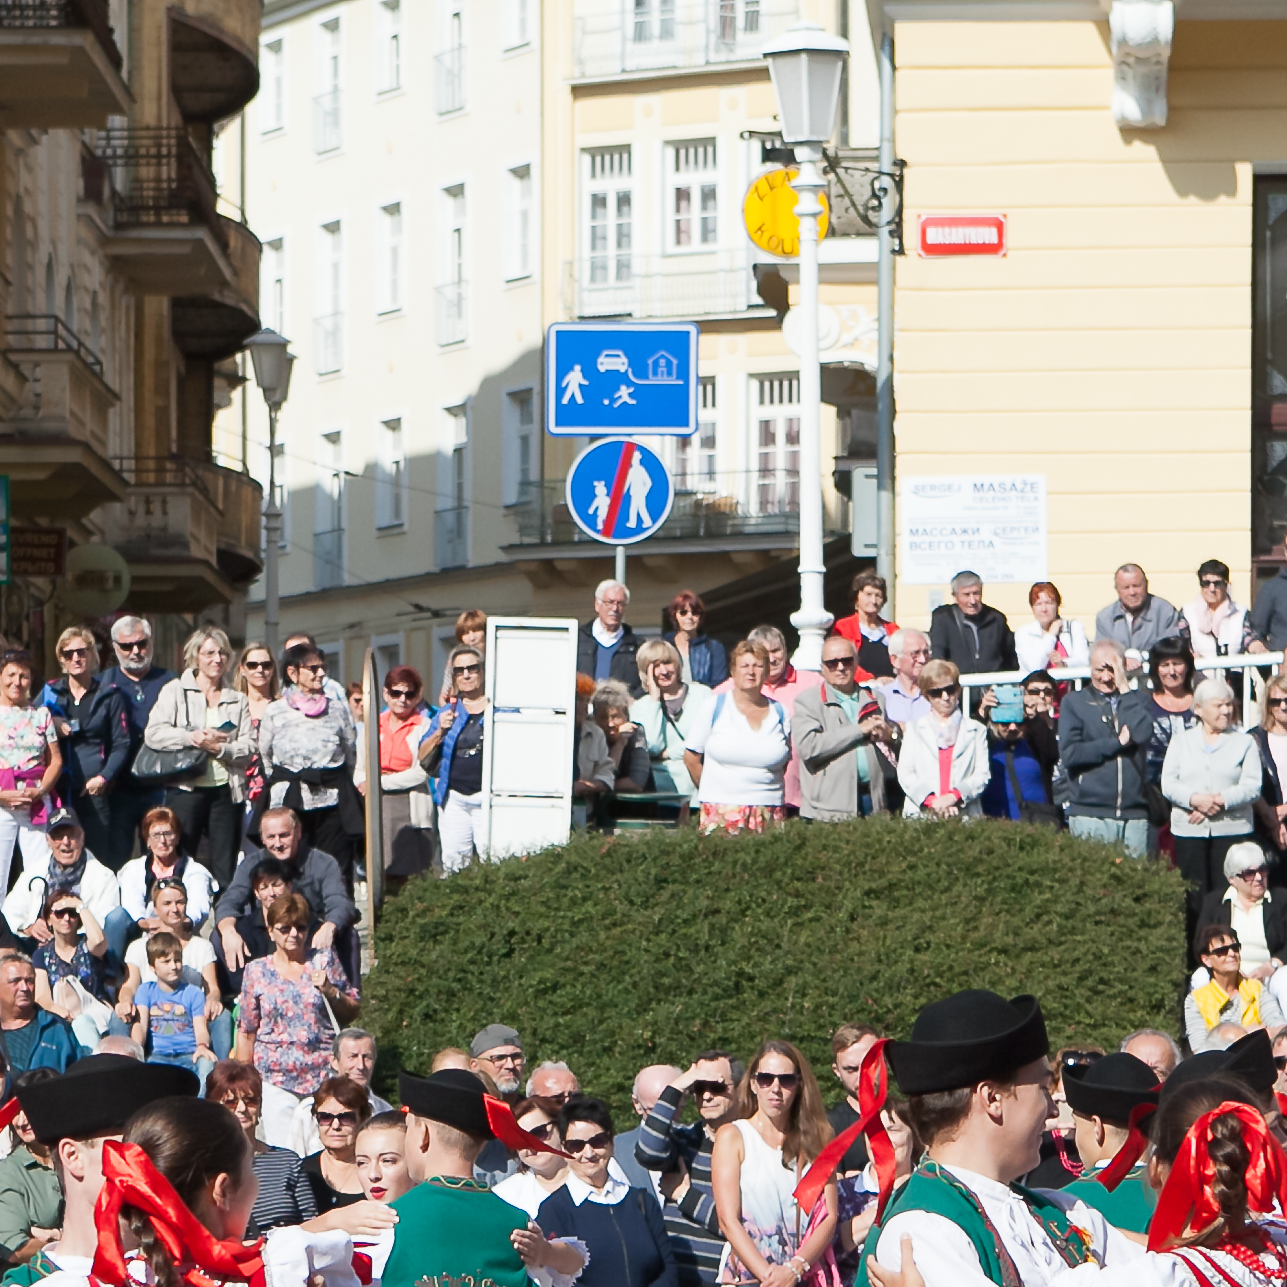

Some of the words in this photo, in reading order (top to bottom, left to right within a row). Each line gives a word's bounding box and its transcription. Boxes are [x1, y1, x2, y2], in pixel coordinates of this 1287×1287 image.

[754, 222, 800, 255] KOU
[913, 483, 962, 494] SERGEJ
[973, 479, 1039, 494] MASÁŽE
[909, 527, 980, 538] МАССАЖИ
[909, 540, 955, 551] ВСЕГО
